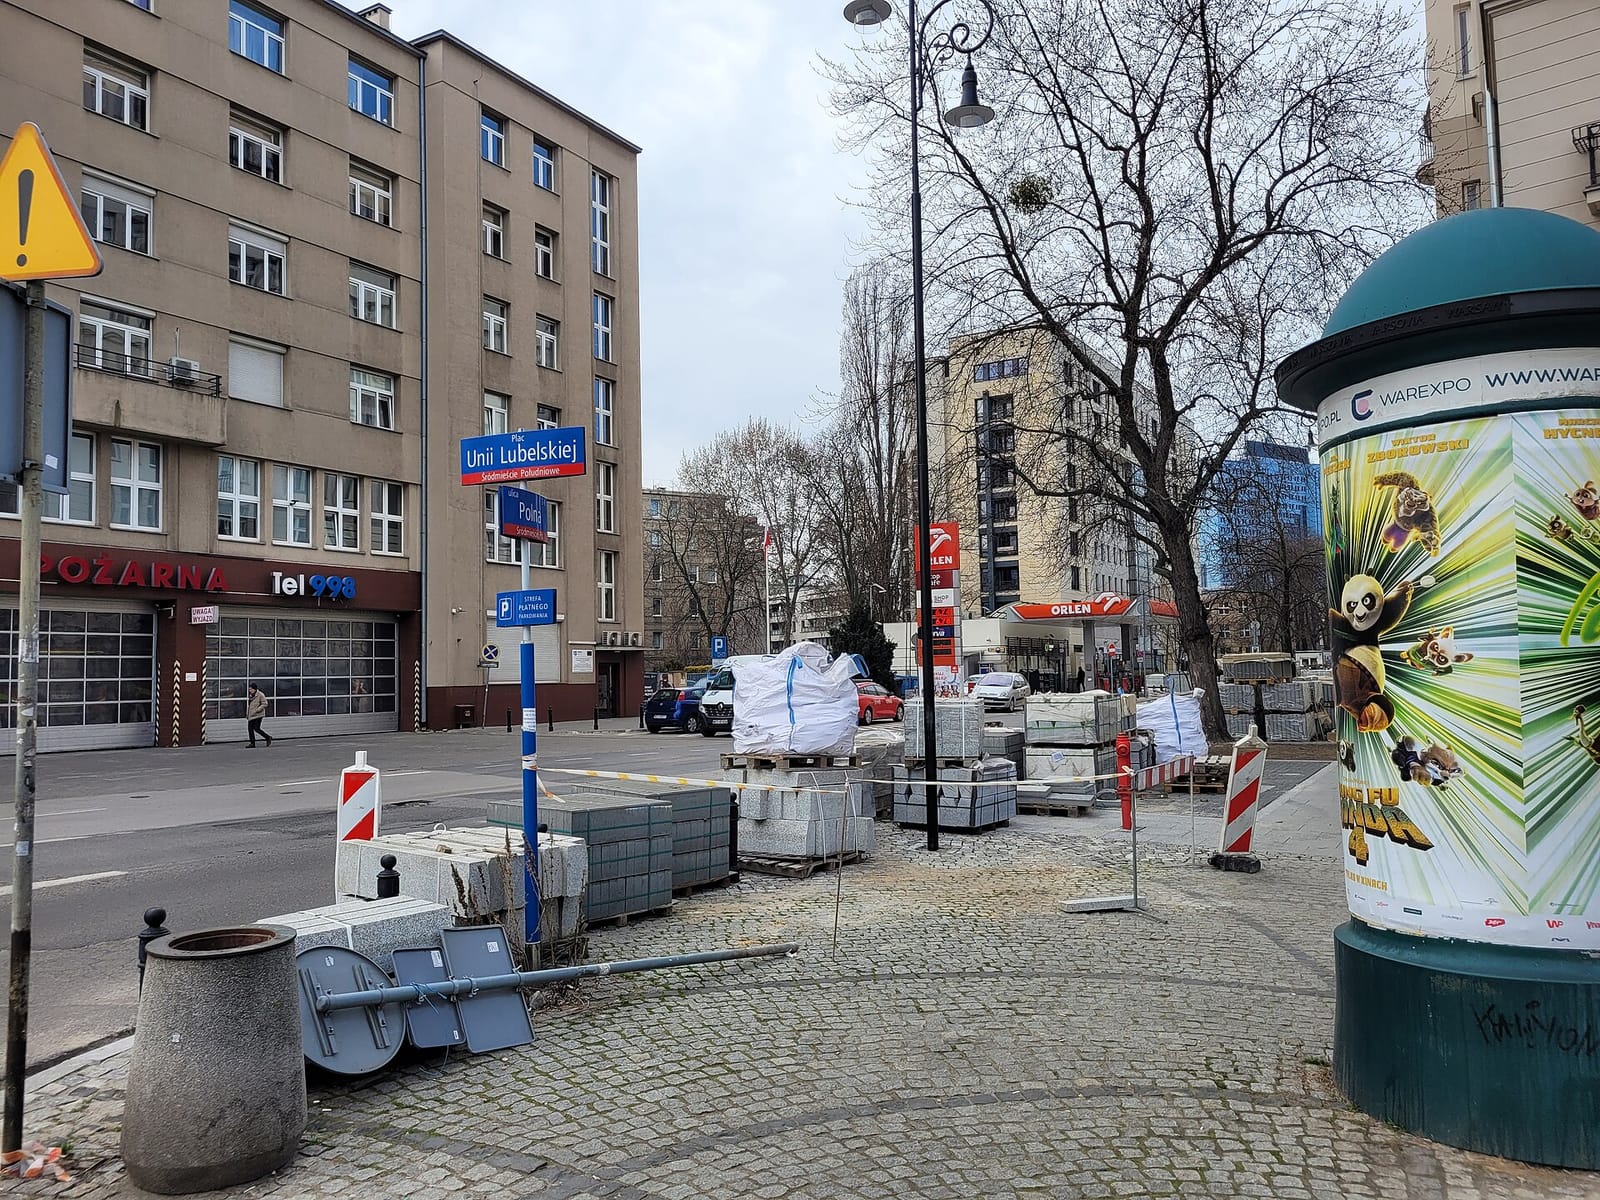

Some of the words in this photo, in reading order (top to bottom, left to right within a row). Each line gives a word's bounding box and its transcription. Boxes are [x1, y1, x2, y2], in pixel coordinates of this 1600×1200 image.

[1379, 377, 1472, 407] WAREXPO
[511, 434, 525, 443] Plac
[1391, 433, 1436, 447] WIKTOR
[467, 447, 494, 468] Unii
[500, 439, 577, 464] Lubelskiej
[1367, 438, 1470, 464] ZBOROWSKI
[481, 471, 518, 482] Śródmieście
[520, 466, 560, 478] Południowe
[507, 489, 519, 498] ulica
[519, 501, 542, 524] Polna
[40, 552, 230, 592] POŻARNA
[271, 571, 305, 596] Tel
[309, 574, 356, 599] 998
[501, 600, 510, 617] P
[1051, 603, 1092, 616] ORLEN
[714, 638, 723, 652] P
[1367, 787, 1400, 807] FU
[1348, 826, 1369, 867] 4
